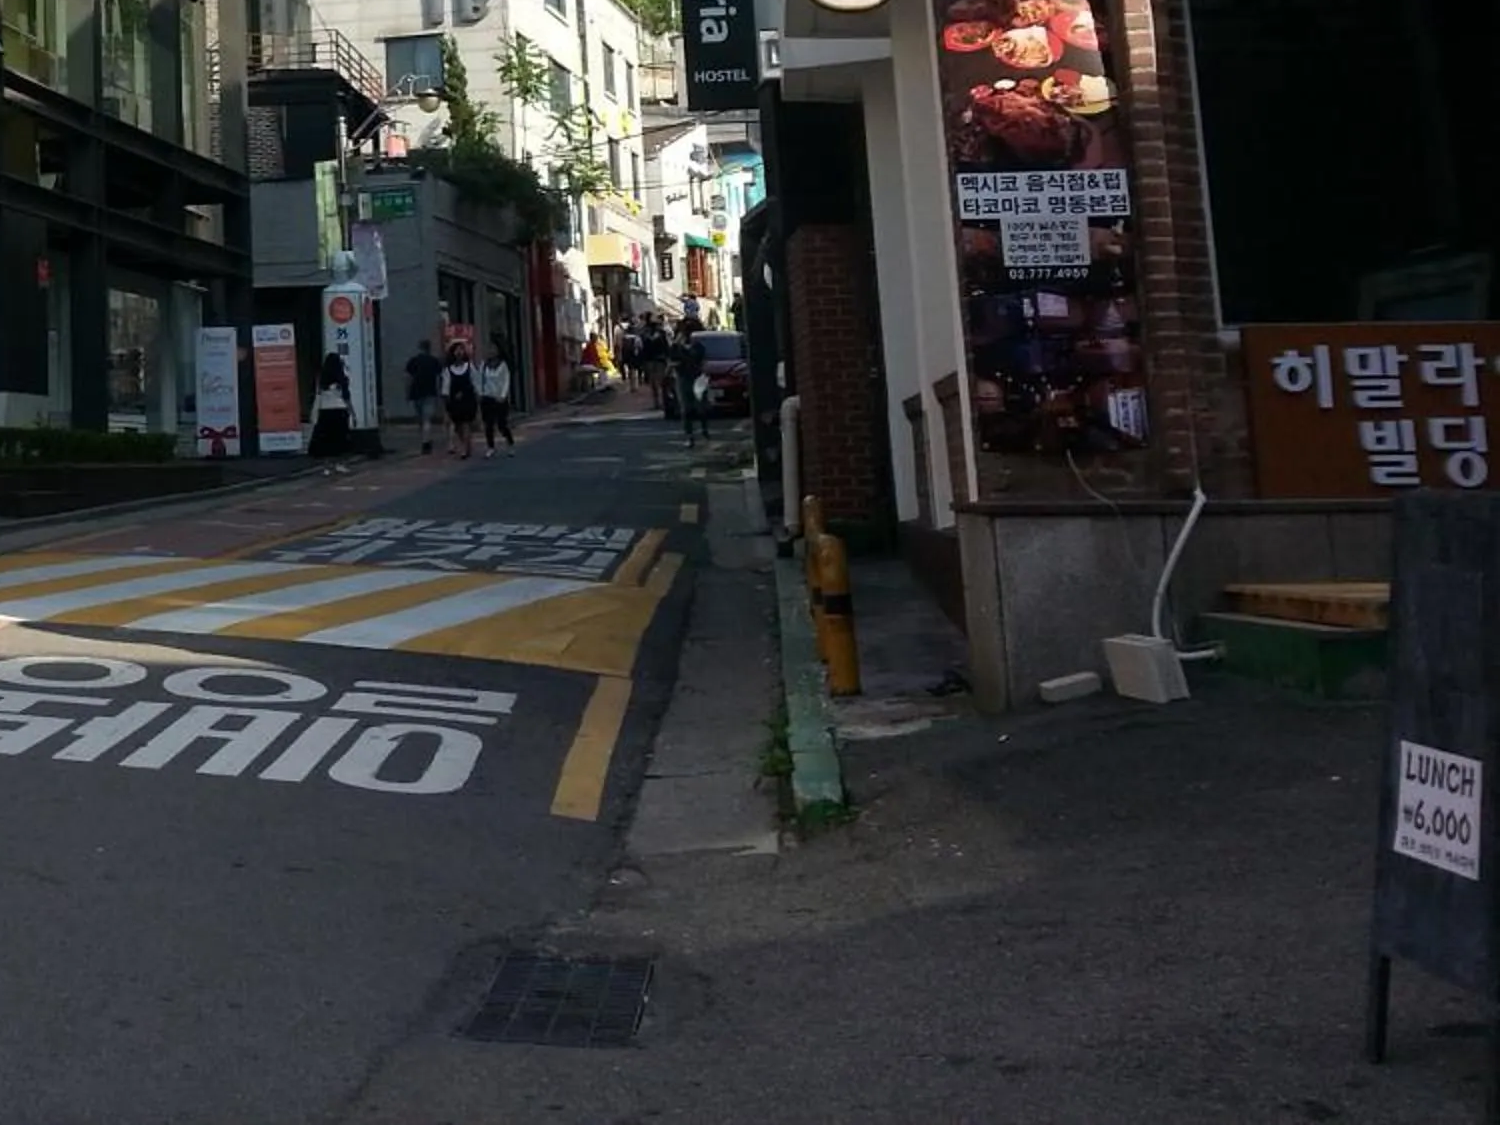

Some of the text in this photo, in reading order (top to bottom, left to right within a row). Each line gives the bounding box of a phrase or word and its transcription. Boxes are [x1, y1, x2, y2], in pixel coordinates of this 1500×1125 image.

[694, 70, 750, 83] HOSTEL
[961, 175, 1019, 193] 멕시코
[963, 194, 1128, 215] 타코마코 명동본점
[1270, 343, 1500, 409] 히말라
[1359, 415, 1488, 488] 빌딩
[1405, 750, 1475, 798] LUNCH
